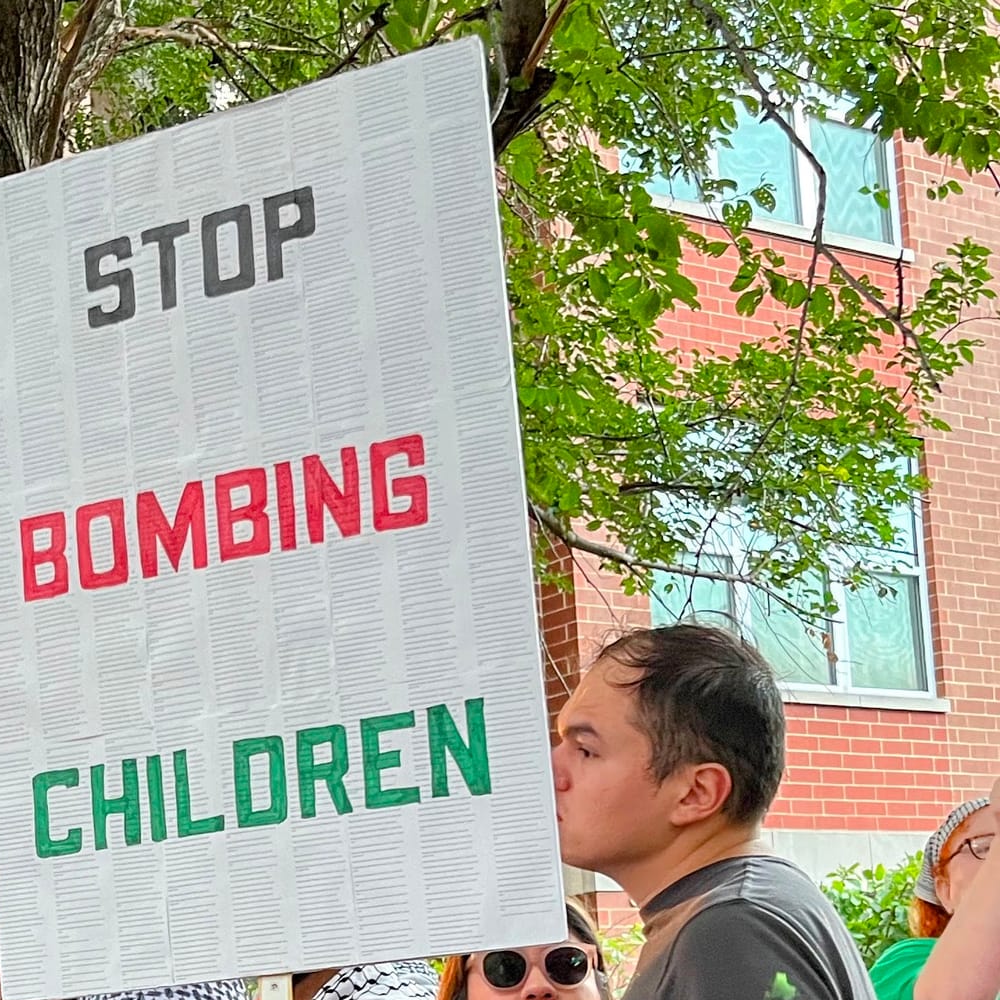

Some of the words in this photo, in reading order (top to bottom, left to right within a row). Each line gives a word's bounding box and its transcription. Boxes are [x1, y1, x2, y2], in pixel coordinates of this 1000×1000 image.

[84, 186, 316, 329] STOP
[20, 434, 428, 602] BOMBING
[32, 698, 492, 858] CHILDREN
